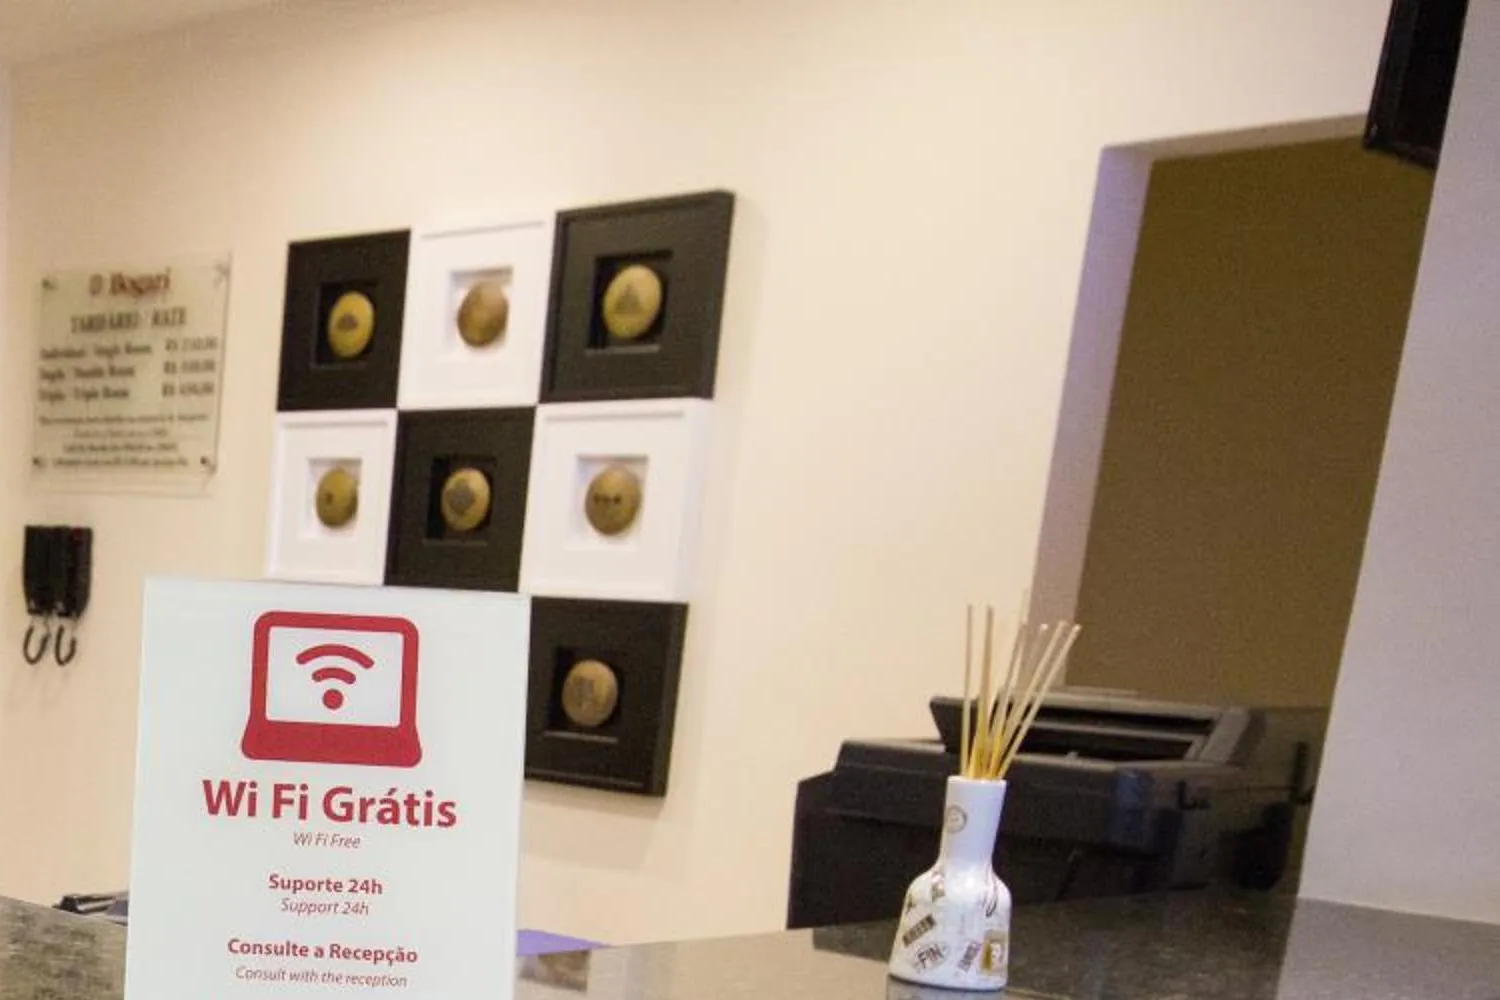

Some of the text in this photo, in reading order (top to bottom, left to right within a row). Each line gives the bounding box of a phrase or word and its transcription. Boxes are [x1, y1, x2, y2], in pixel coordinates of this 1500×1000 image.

[202, 779, 457, 827] Wi Fi Grátis
[293, 832, 361, 849] Wi Fi Free
[268, 873, 384, 895] Suporte 24h
[280, 898, 370, 916] Support 24h
[227, 938, 419, 966] Consulte a Recepção
[235, 966, 408, 988] Consult with the reception
